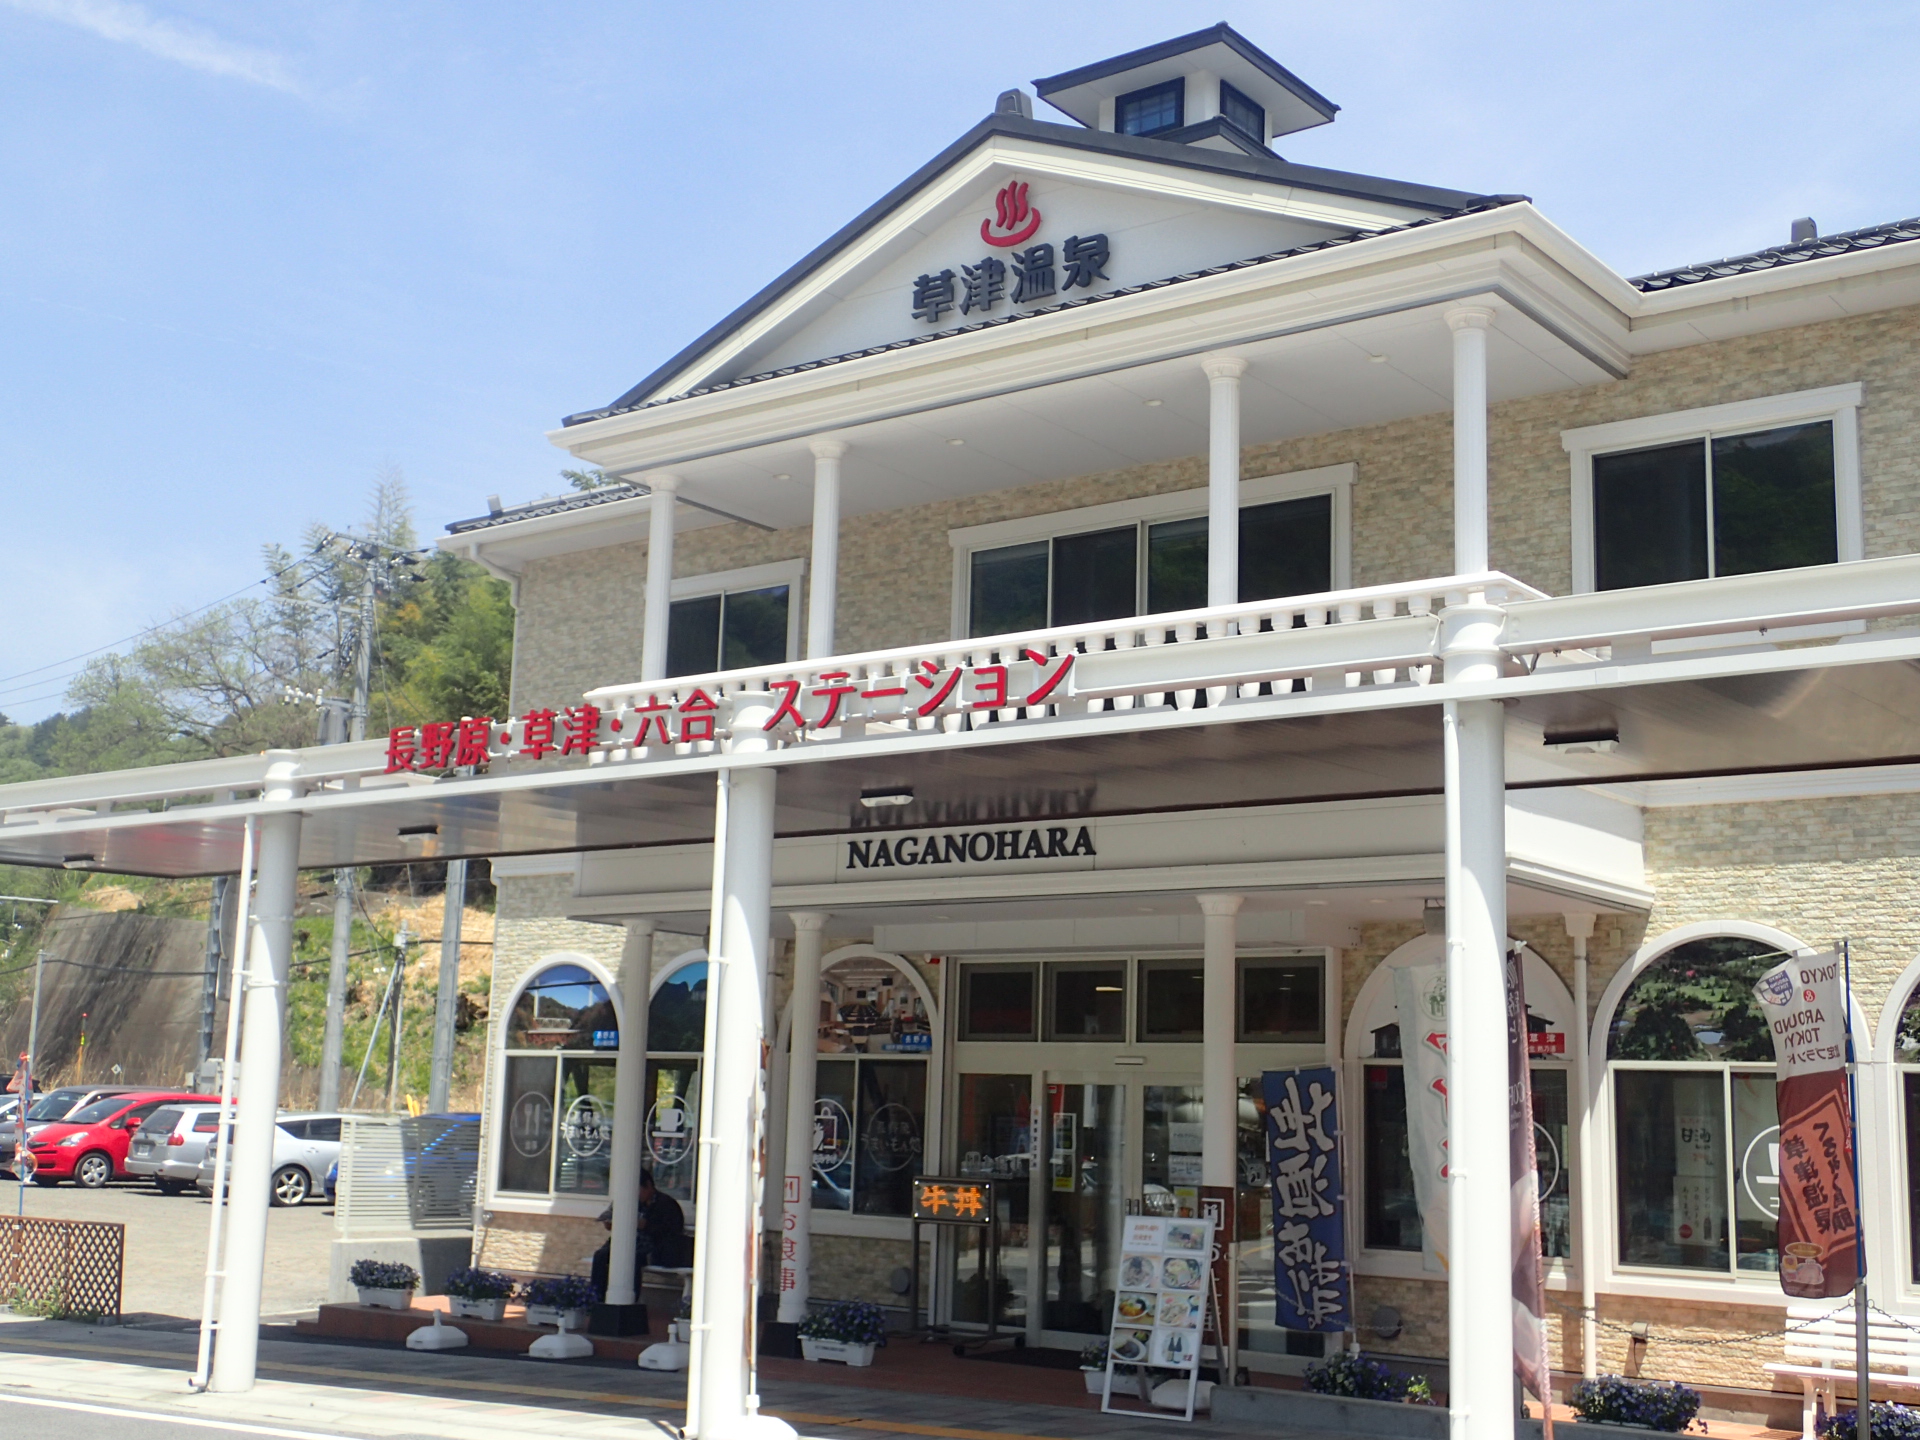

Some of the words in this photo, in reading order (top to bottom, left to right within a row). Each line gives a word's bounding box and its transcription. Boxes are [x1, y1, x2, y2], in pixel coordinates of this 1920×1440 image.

[911, 233, 1110, 323] 草津温泉
[763, 649, 1076, 731] ステーション
[846, 825, 1097, 870] NAGANOHARA
[920, 1185, 983, 1217] 牛丼
